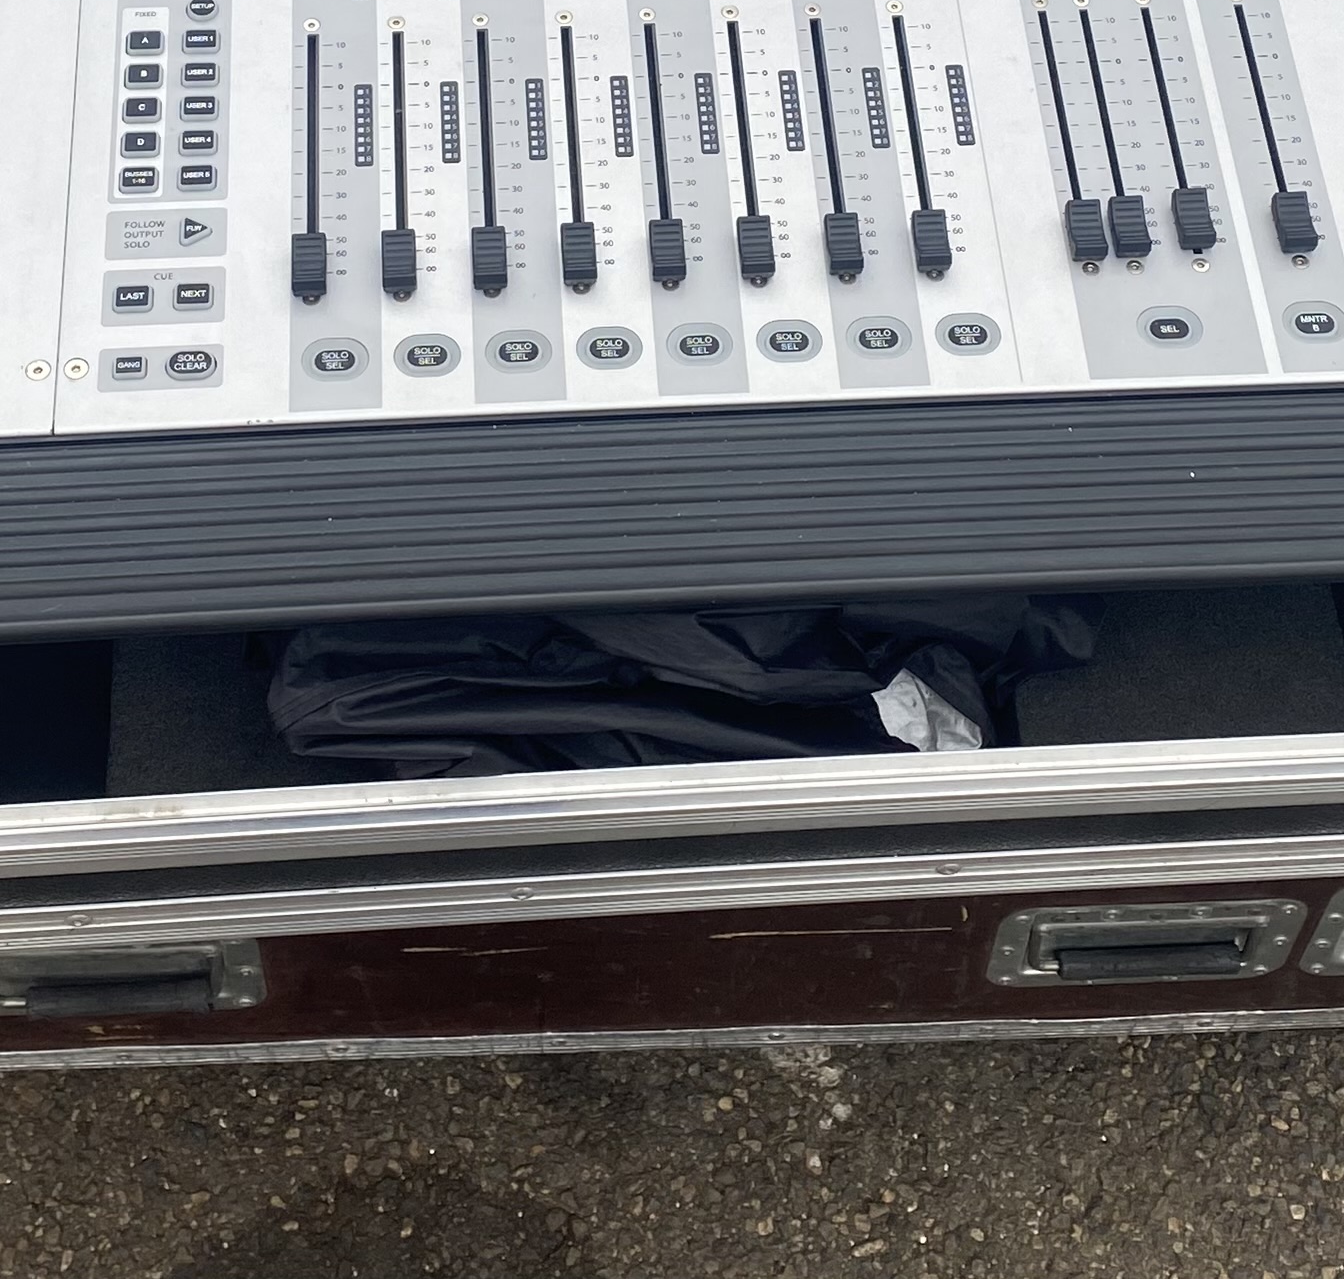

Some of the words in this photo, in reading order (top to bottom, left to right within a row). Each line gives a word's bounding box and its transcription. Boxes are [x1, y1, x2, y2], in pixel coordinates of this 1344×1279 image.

[124, 241, 150, 249] SOLO
[120, 292, 145, 300] LAST
[181, 290, 206, 298] NEXT
[1300, 315, 1327, 323] MNTR
[954, 326, 980, 334] SOLO
[1160, 324, 1179, 333] SEL
[776, 332, 802, 340] SOLO
[959, 336, 978, 344] SEL
[596, 339, 623, 347] SOLO
[781, 342, 799, 350] SEL
[414, 346, 441, 355] SOLO
[601, 349, 619, 357] SEL
[177, 354, 204, 362] SOLO
[322, 351, 348, 360] SOLO
[326, 361, 344, 369] SEL
[418, 357, 436, 365] SEL
[174, 362, 206, 370] CLEAR
